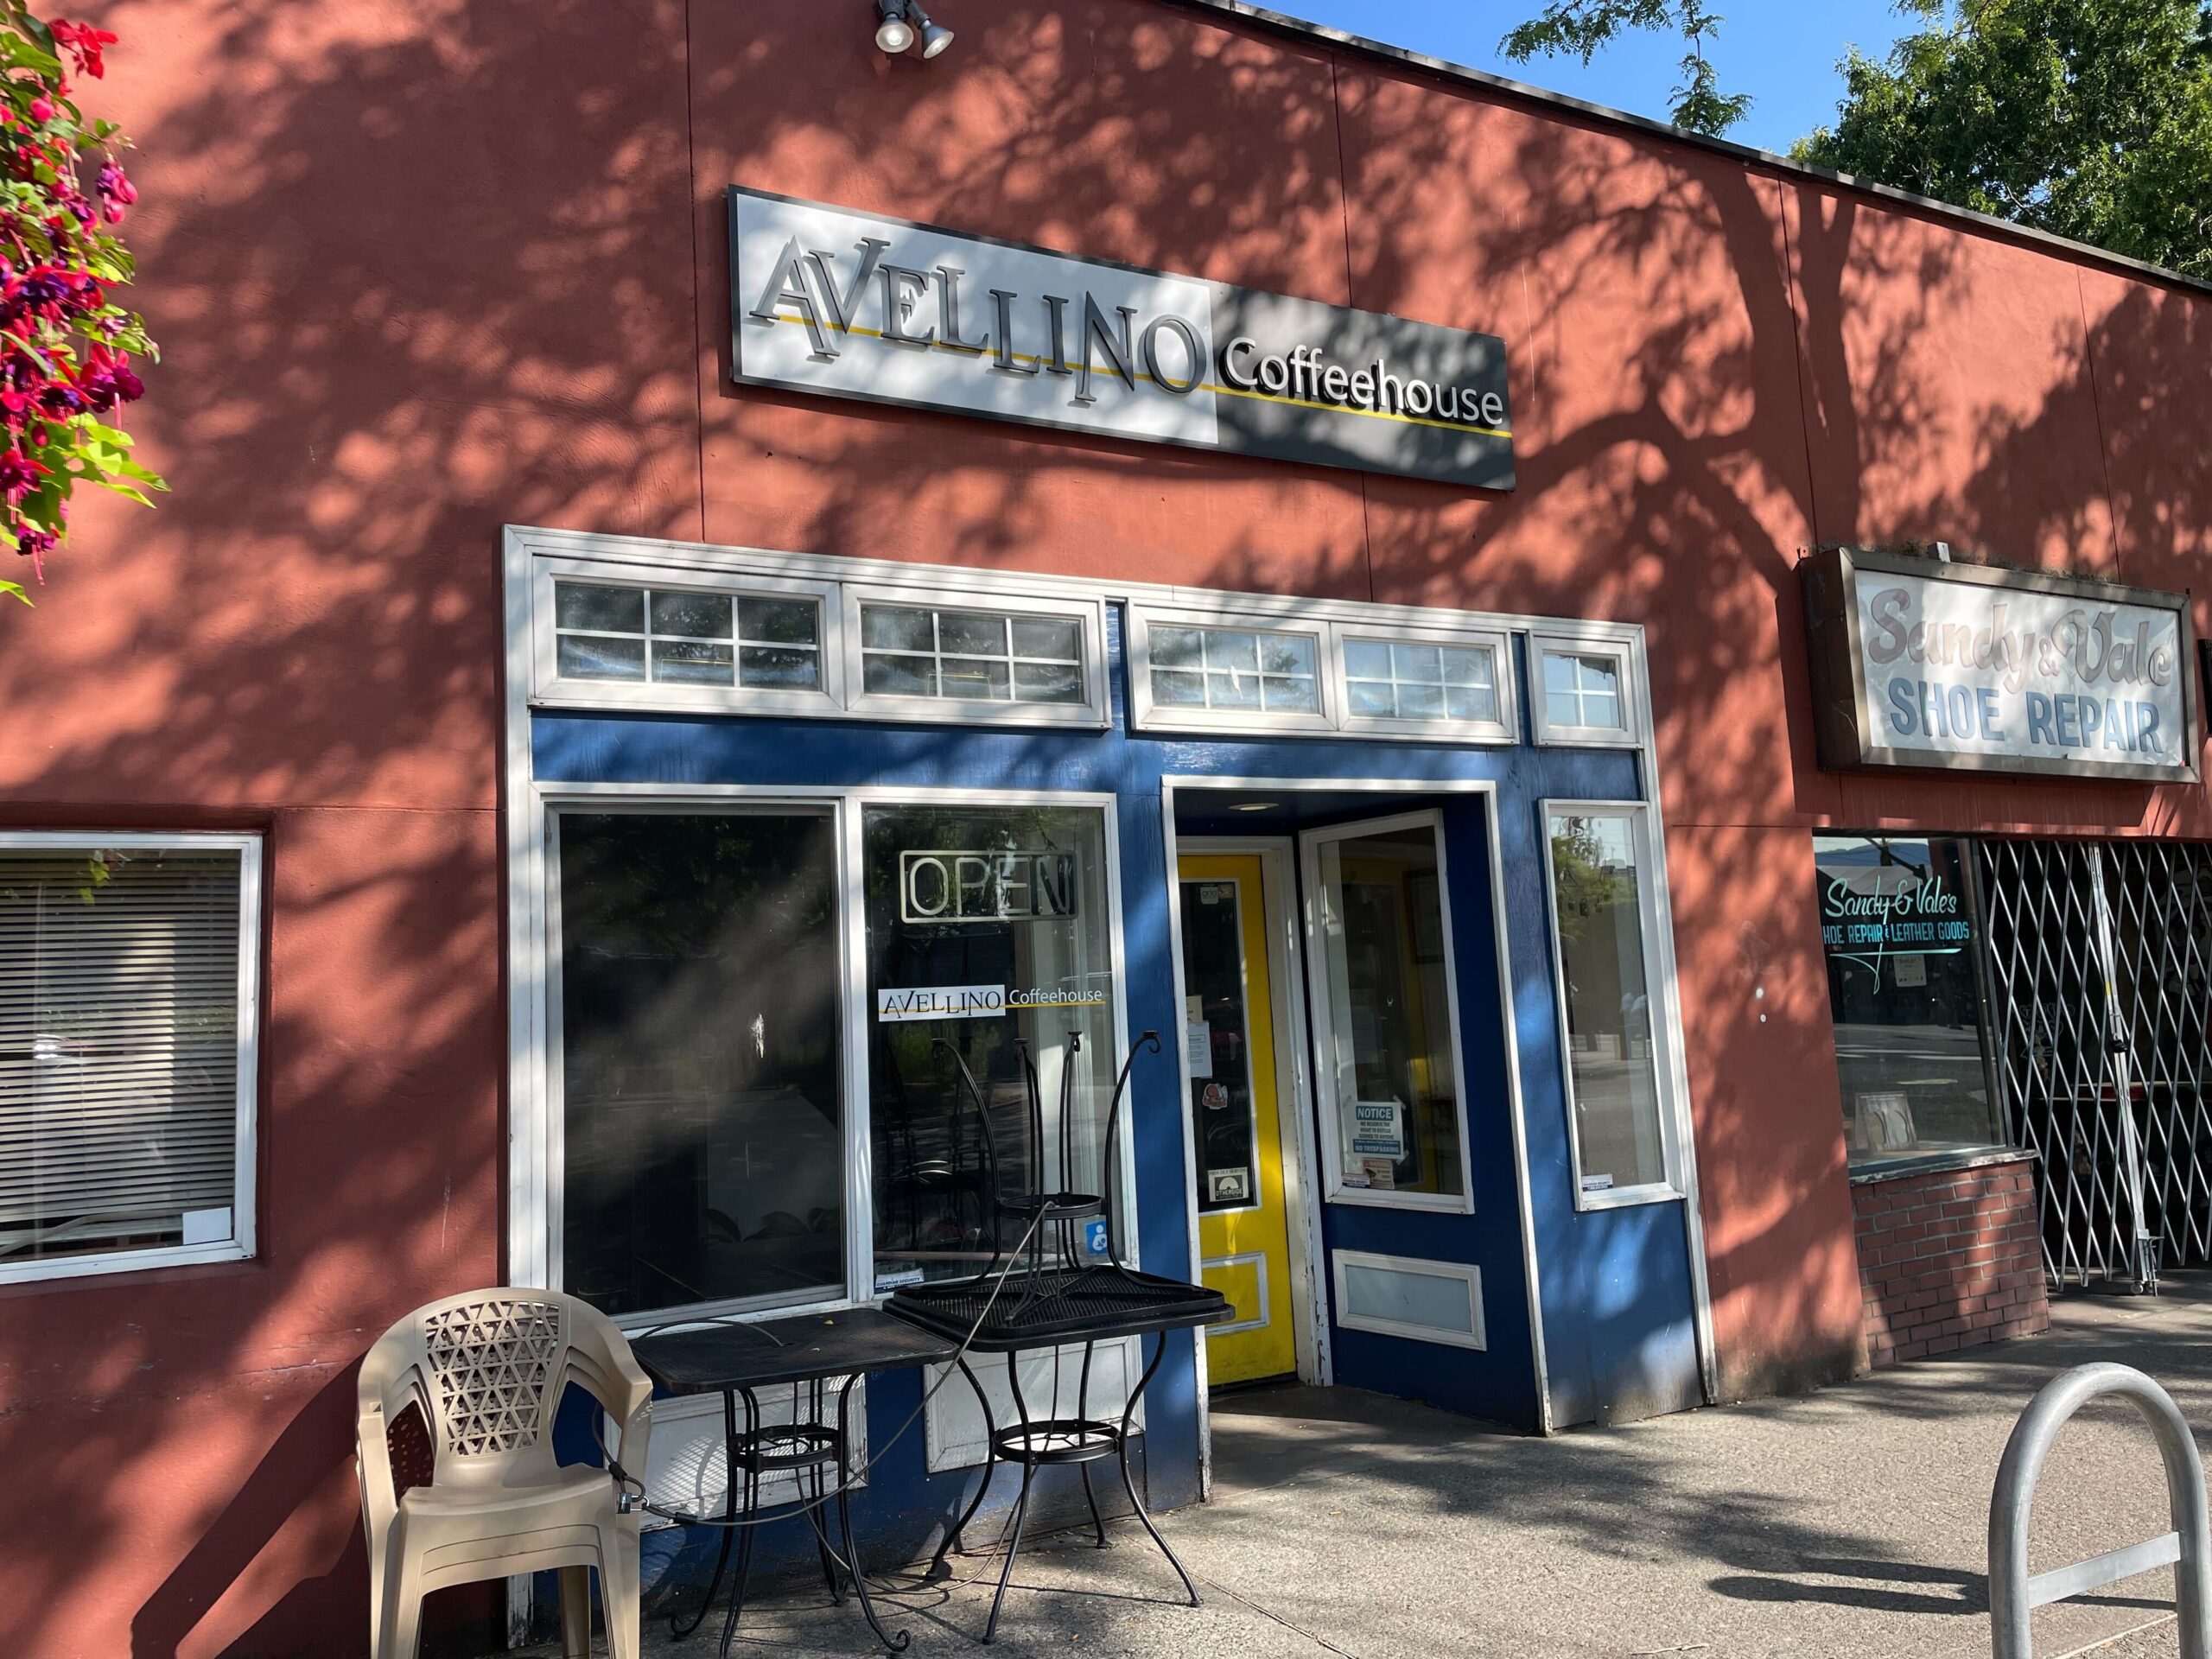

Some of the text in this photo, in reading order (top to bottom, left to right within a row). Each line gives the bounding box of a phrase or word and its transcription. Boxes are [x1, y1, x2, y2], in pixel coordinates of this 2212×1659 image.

[749, 234, 1503, 426] AVELLINO Coffeehouse
[1868, 588, 2173, 695] Sandy & Vale
[1889, 677, 2164, 753] SHOE REPAIR
[910, 856, 1071, 916] OPEN
[1825, 875, 1890, 925] Sandy
[1916, 875, 1957, 914] Vale's
[1822, 925, 1844, 944] HOE
[1848, 924, 1884, 944] REPAIR
[1891, 922, 1935, 942] LEATHER
[1937, 921, 1970, 940] GOODS
[884, 988, 1103, 1018] AVELLINO Coffeehouse
[1357, 1108, 1392, 1119] NOTICE
